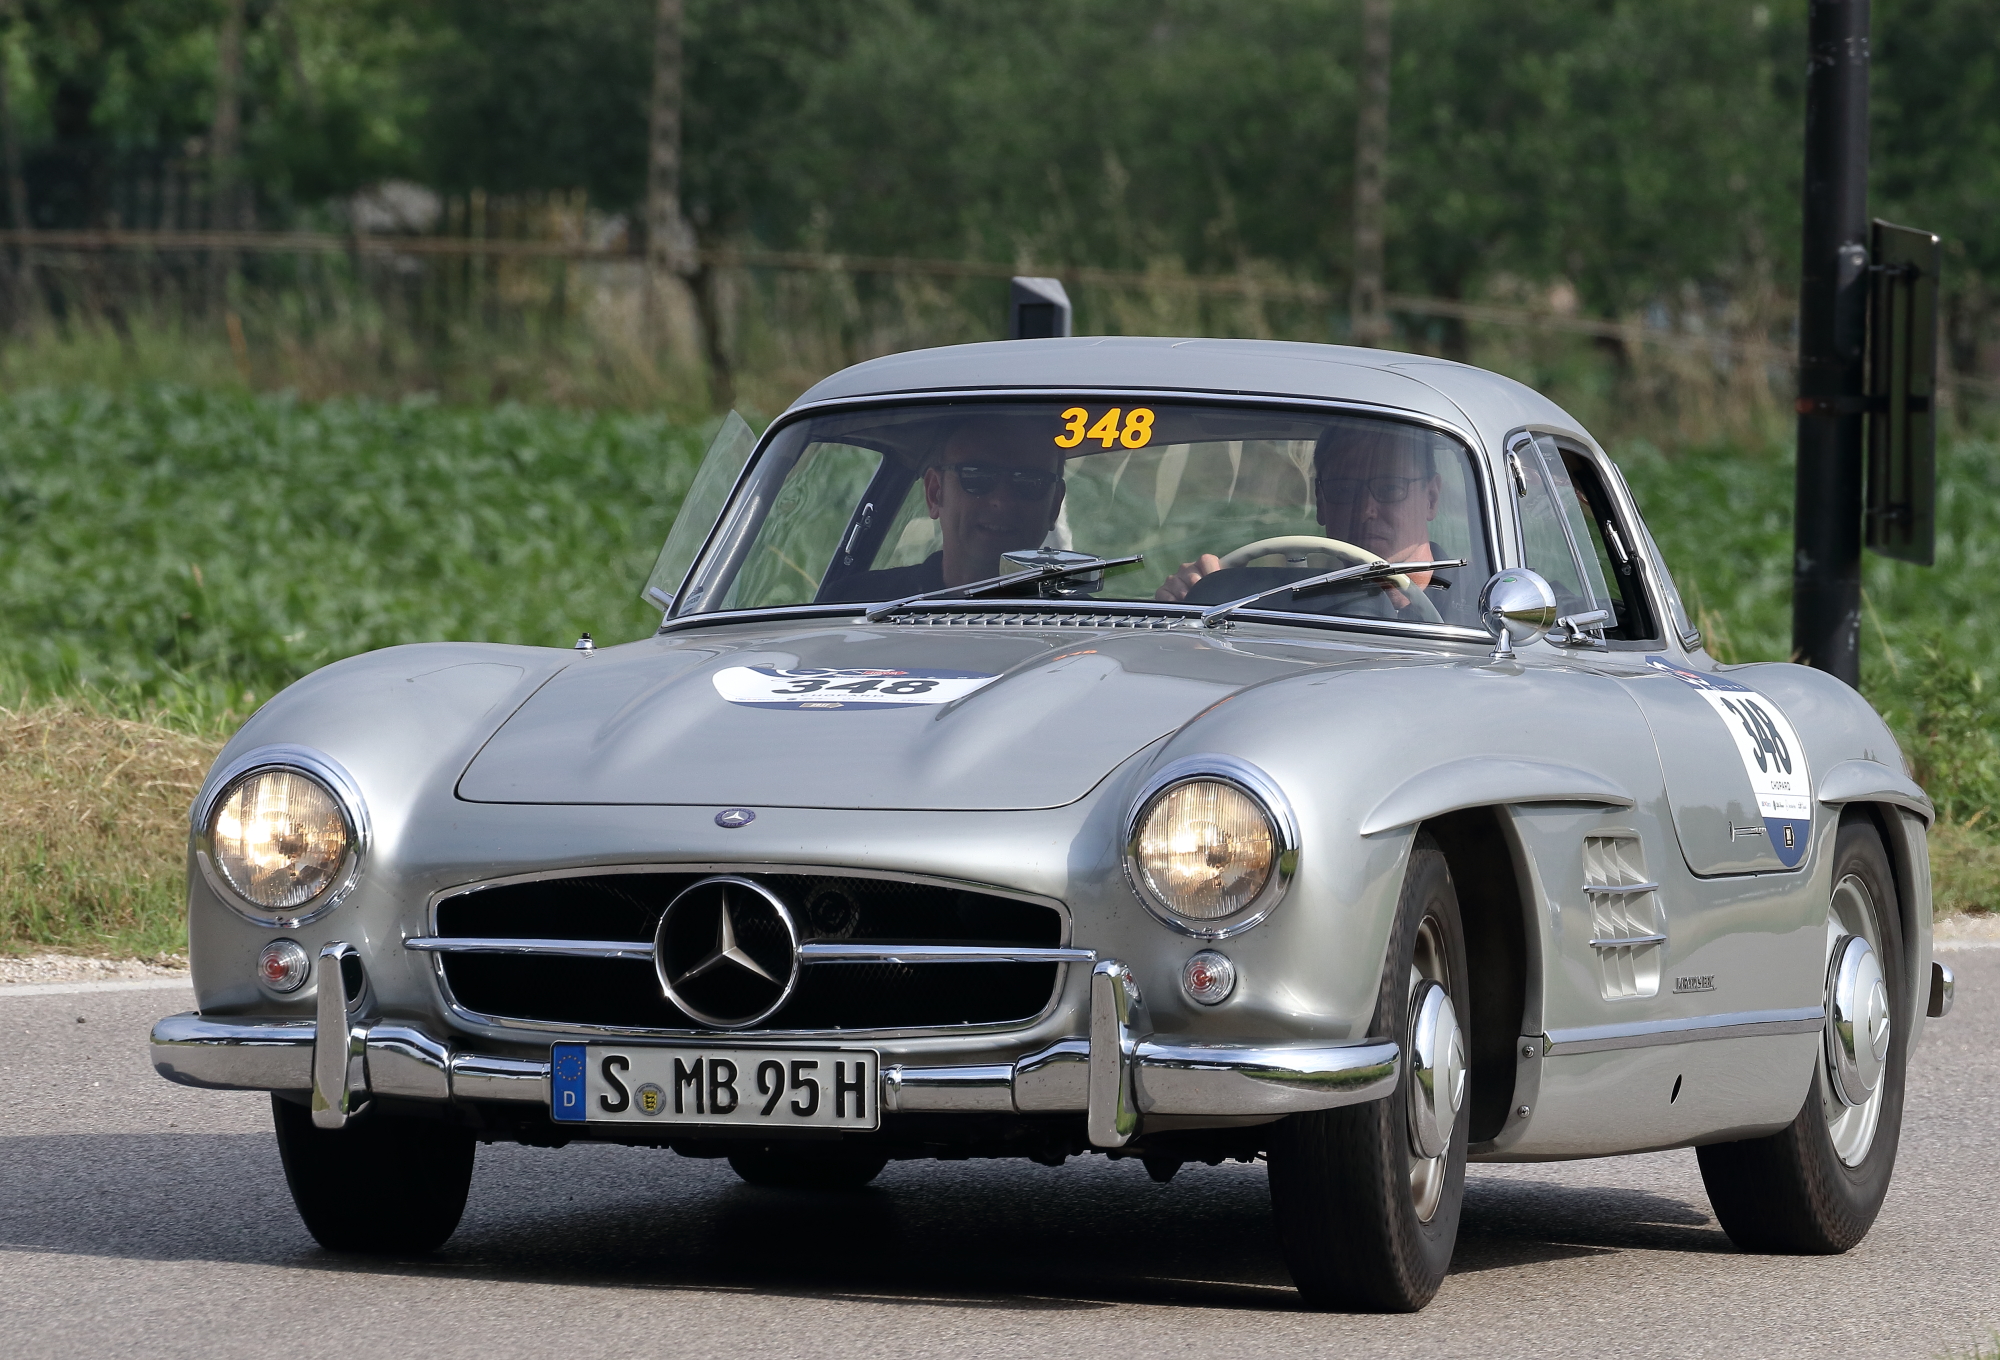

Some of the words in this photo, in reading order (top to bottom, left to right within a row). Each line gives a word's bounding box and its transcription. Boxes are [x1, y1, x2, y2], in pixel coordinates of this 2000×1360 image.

[1053, 406, 1156, 449] 348
[771, 679, 940, 694] 348
[1719, 696, 1792, 776] 348
[563, 1090, 576, 1107] D
[599, 1054, 631, 1113] S
[673, 1056, 739, 1115] MB
[756, 1059, 821, 1118] 95
[835, 1060, 867, 1119] H
